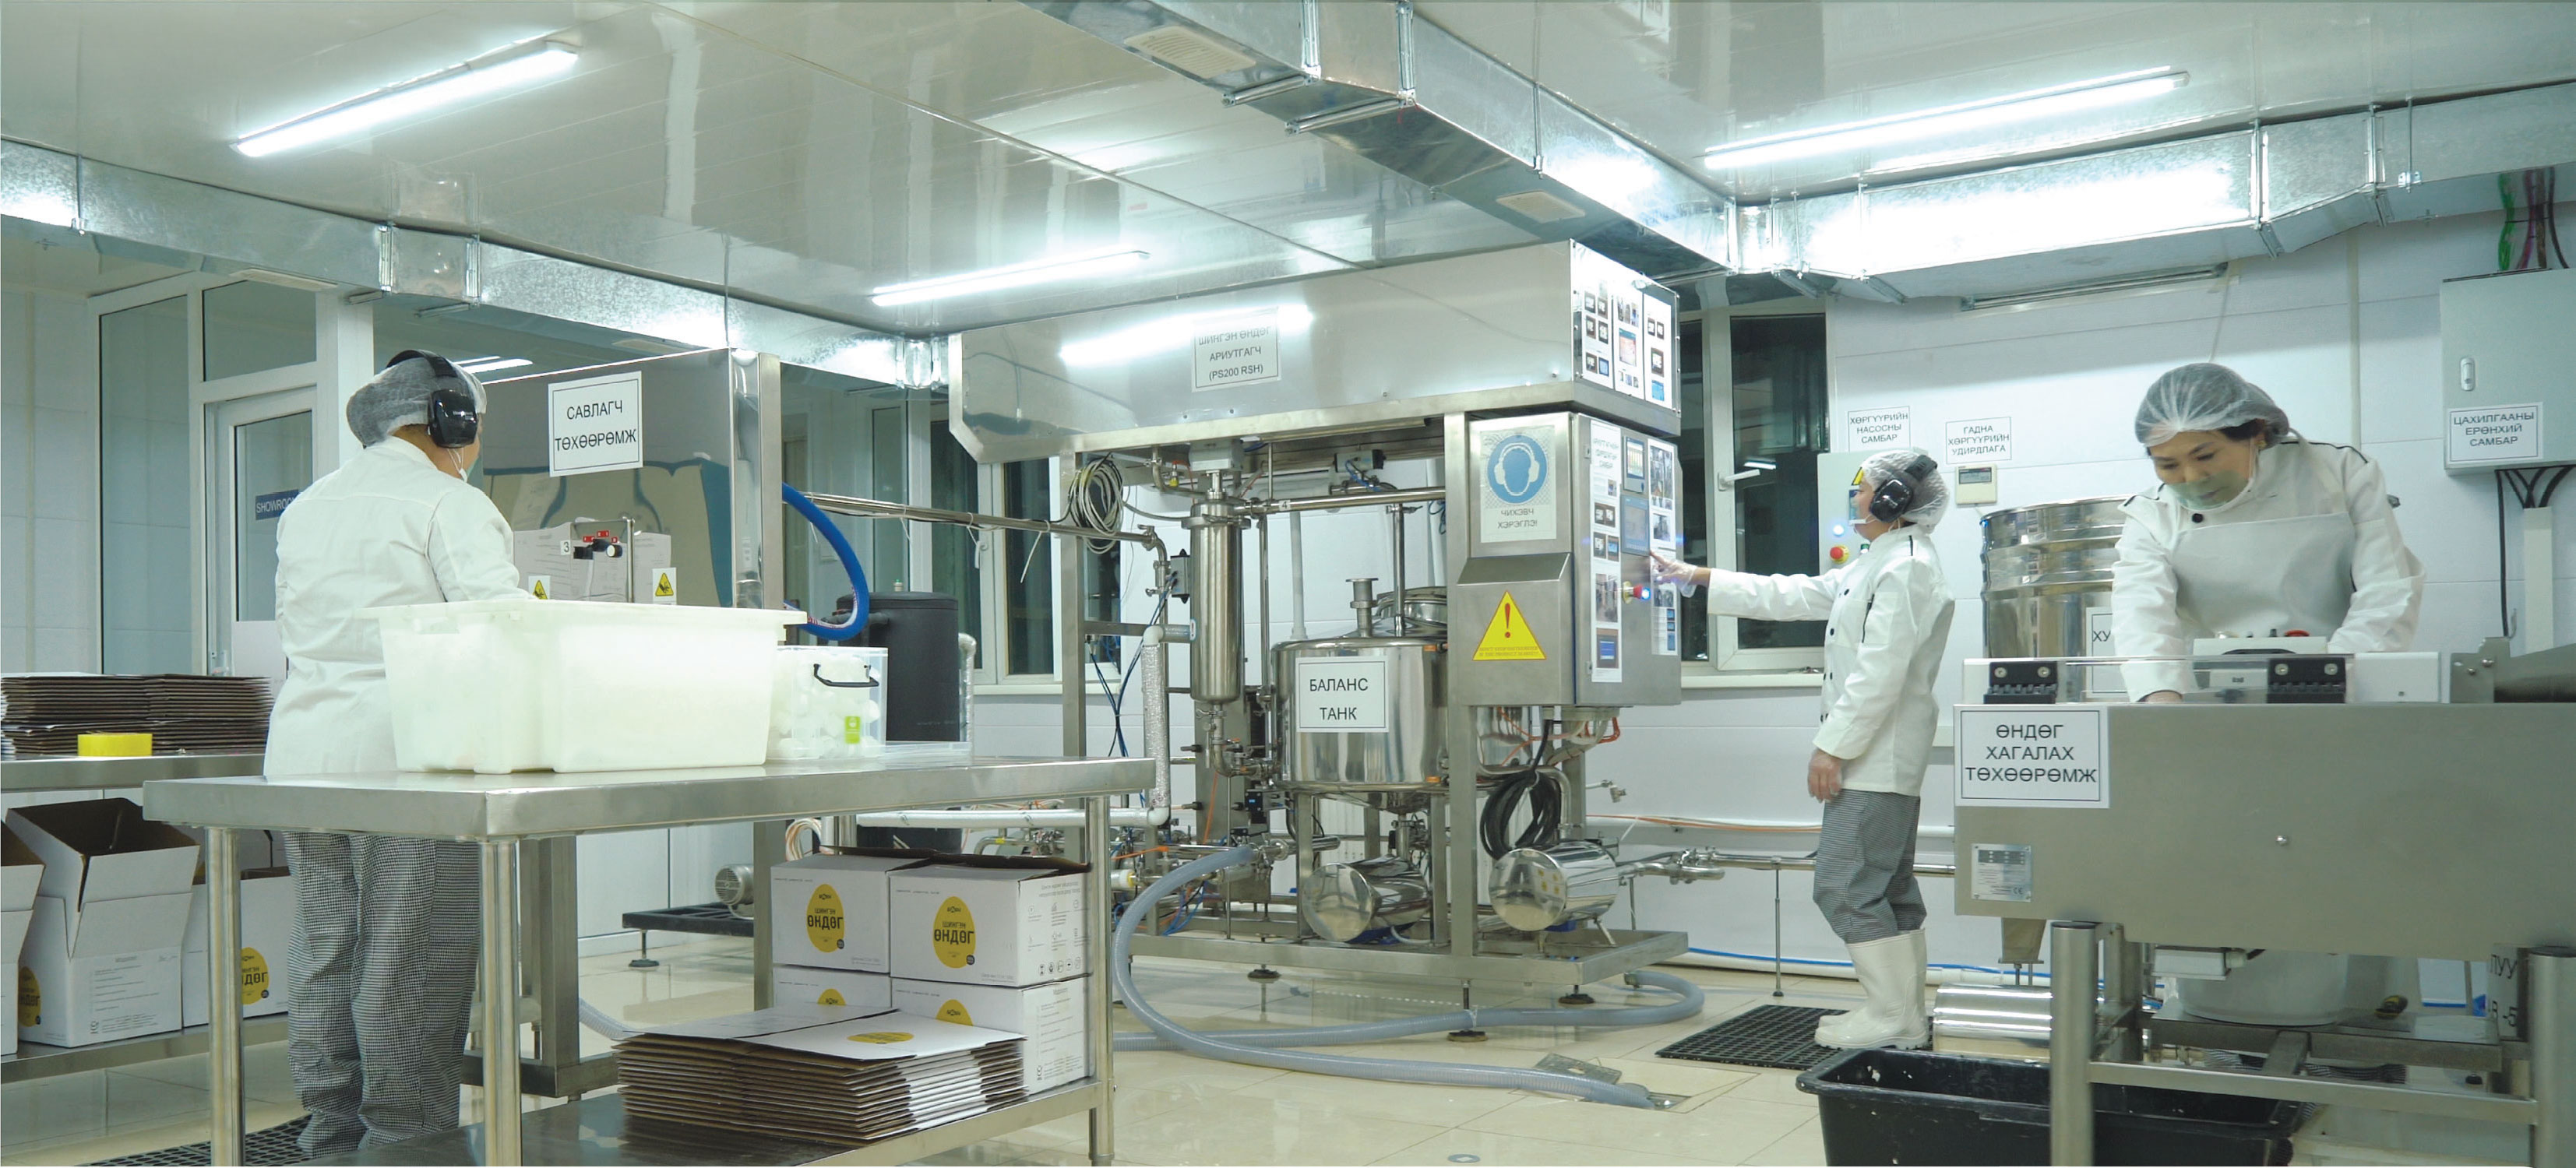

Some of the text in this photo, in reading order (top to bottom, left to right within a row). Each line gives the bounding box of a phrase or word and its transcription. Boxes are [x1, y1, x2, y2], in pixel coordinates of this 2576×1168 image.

[1209, 347, 1262, 362] АРИУТГАГЧ
[1209, 364, 1263, 382] (PS200 RSH)
[567, 399, 622, 420] САВЛАГЧ
[1850, 412, 1908, 424] ХӨРГҮҮРИЙН
[2454, 412, 2534, 426] ЦАХИЛГААНЫ
[1856, 424, 1901, 434] НАСОСНЫ
[1963, 425, 1993, 434] ГАДНА
[2465, 423, 2522, 436] ЕРӨНХИЙ
[555, 429, 637, 452] ТӨХӨӨРӨМЖ
[1861, 434, 1898, 444] САМБАР
[1948, 434, 2010, 446] ХӨРГҮҮРИЙН
[2469, 436, 2518, 447] САМБАР
[1952, 445, 2006, 456] УДИРДЛАГА
[1501, 508, 1534, 517] ЧИХЭВЧ
[1497, 519, 1538, 529] ХЭРЭГЛЭ!
[563, 541, 569, 553] 3
[2092, 630, 2112, 642] ХУ
[1309, 677, 1369, 692] БАЛАНС
[1320, 706, 1357, 720] ТАНК
[1996, 724, 2064, 741] ӨНДӨГ
[1986, 746, 2074, 761] ХАГАЛАХ
[1965, 767, 2097, 783] ТӨХӨӨРӨМЖ
[807, 915, 844, 931] ӨНДӨГ
[934, 929, 974, 945] ӨНДӨГ
[241, 972, 268, 986] ДӨГ
